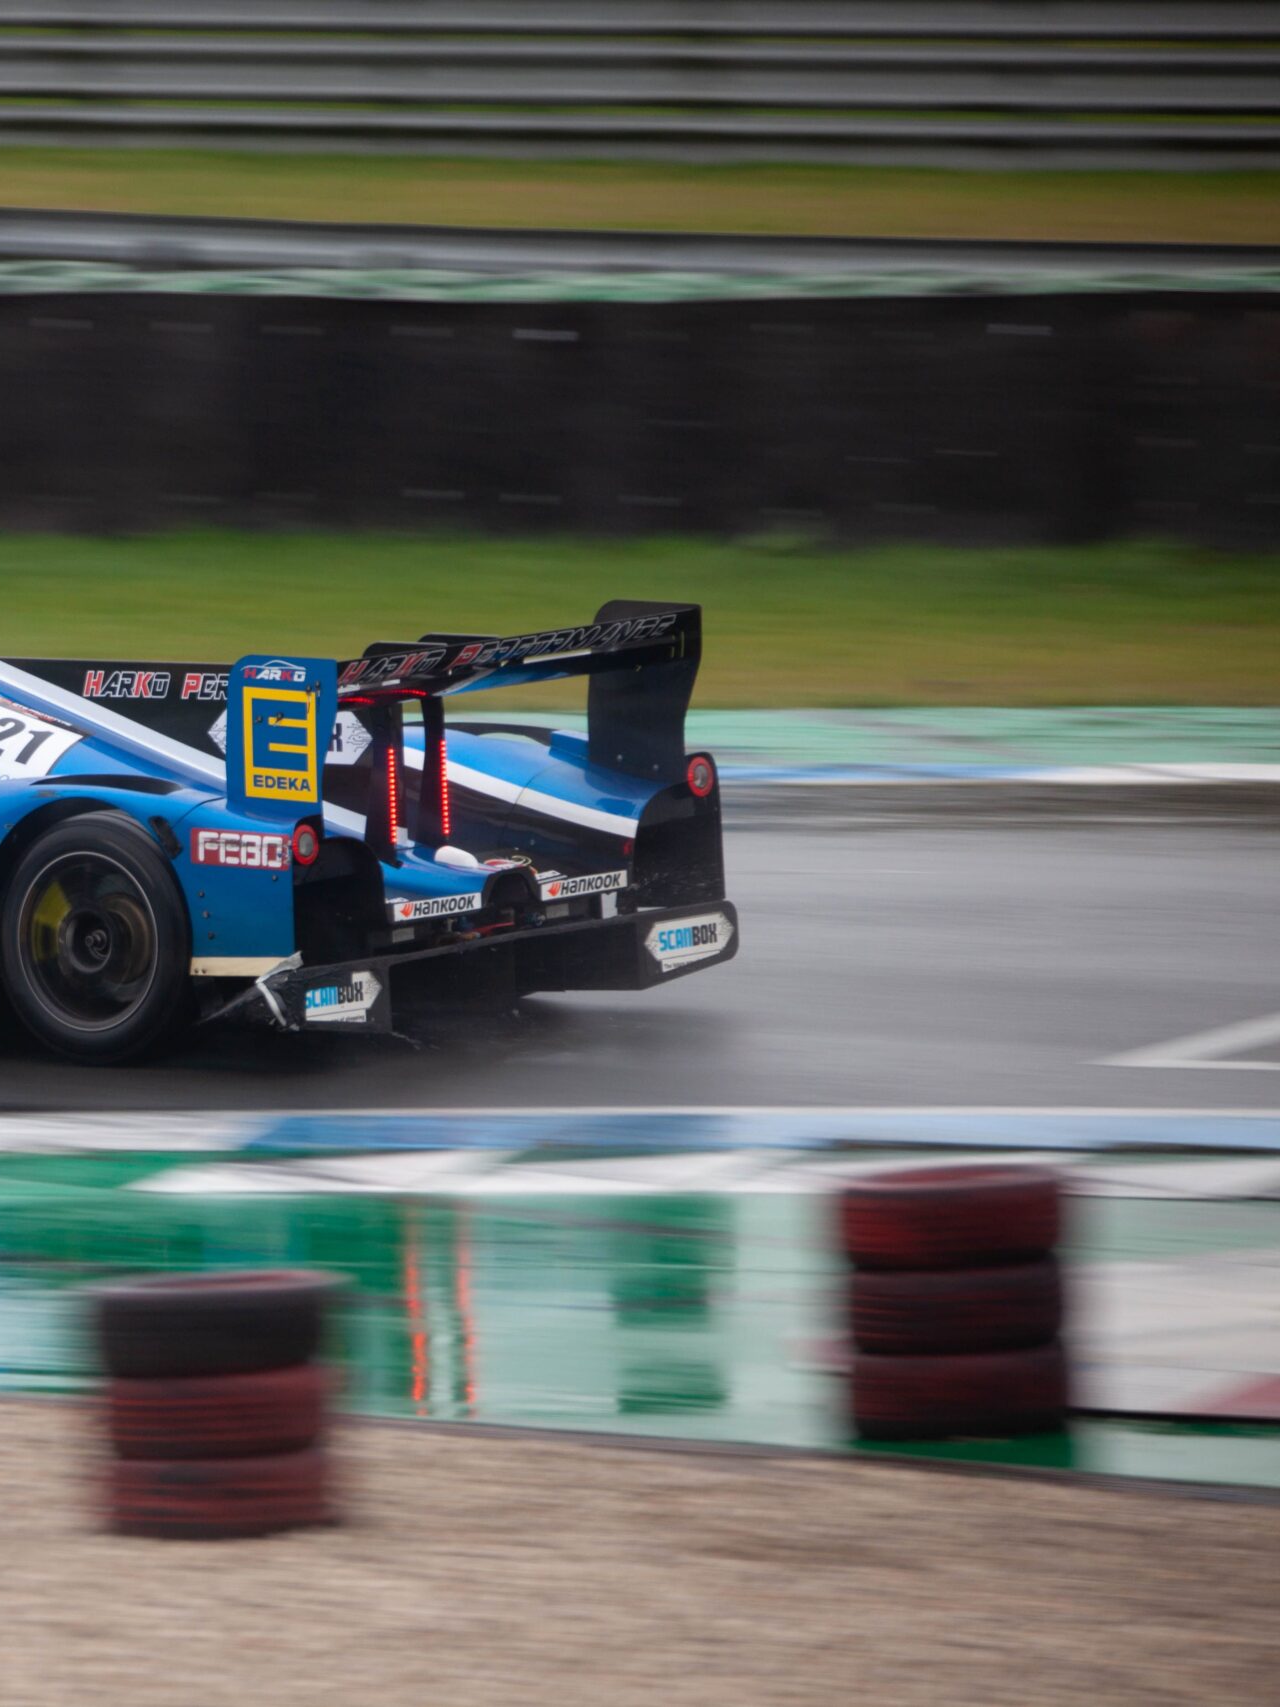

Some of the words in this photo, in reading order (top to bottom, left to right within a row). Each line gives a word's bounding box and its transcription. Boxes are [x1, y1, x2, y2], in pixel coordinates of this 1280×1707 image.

[83, 670, 171, 699] HARKO
[243, 668, 306, 683] HARKO
[253, 774, 311, 792] EDEKA
[198, 831, 284, 868] FEBO
[658, 922, 718, 952] SCANBOX
